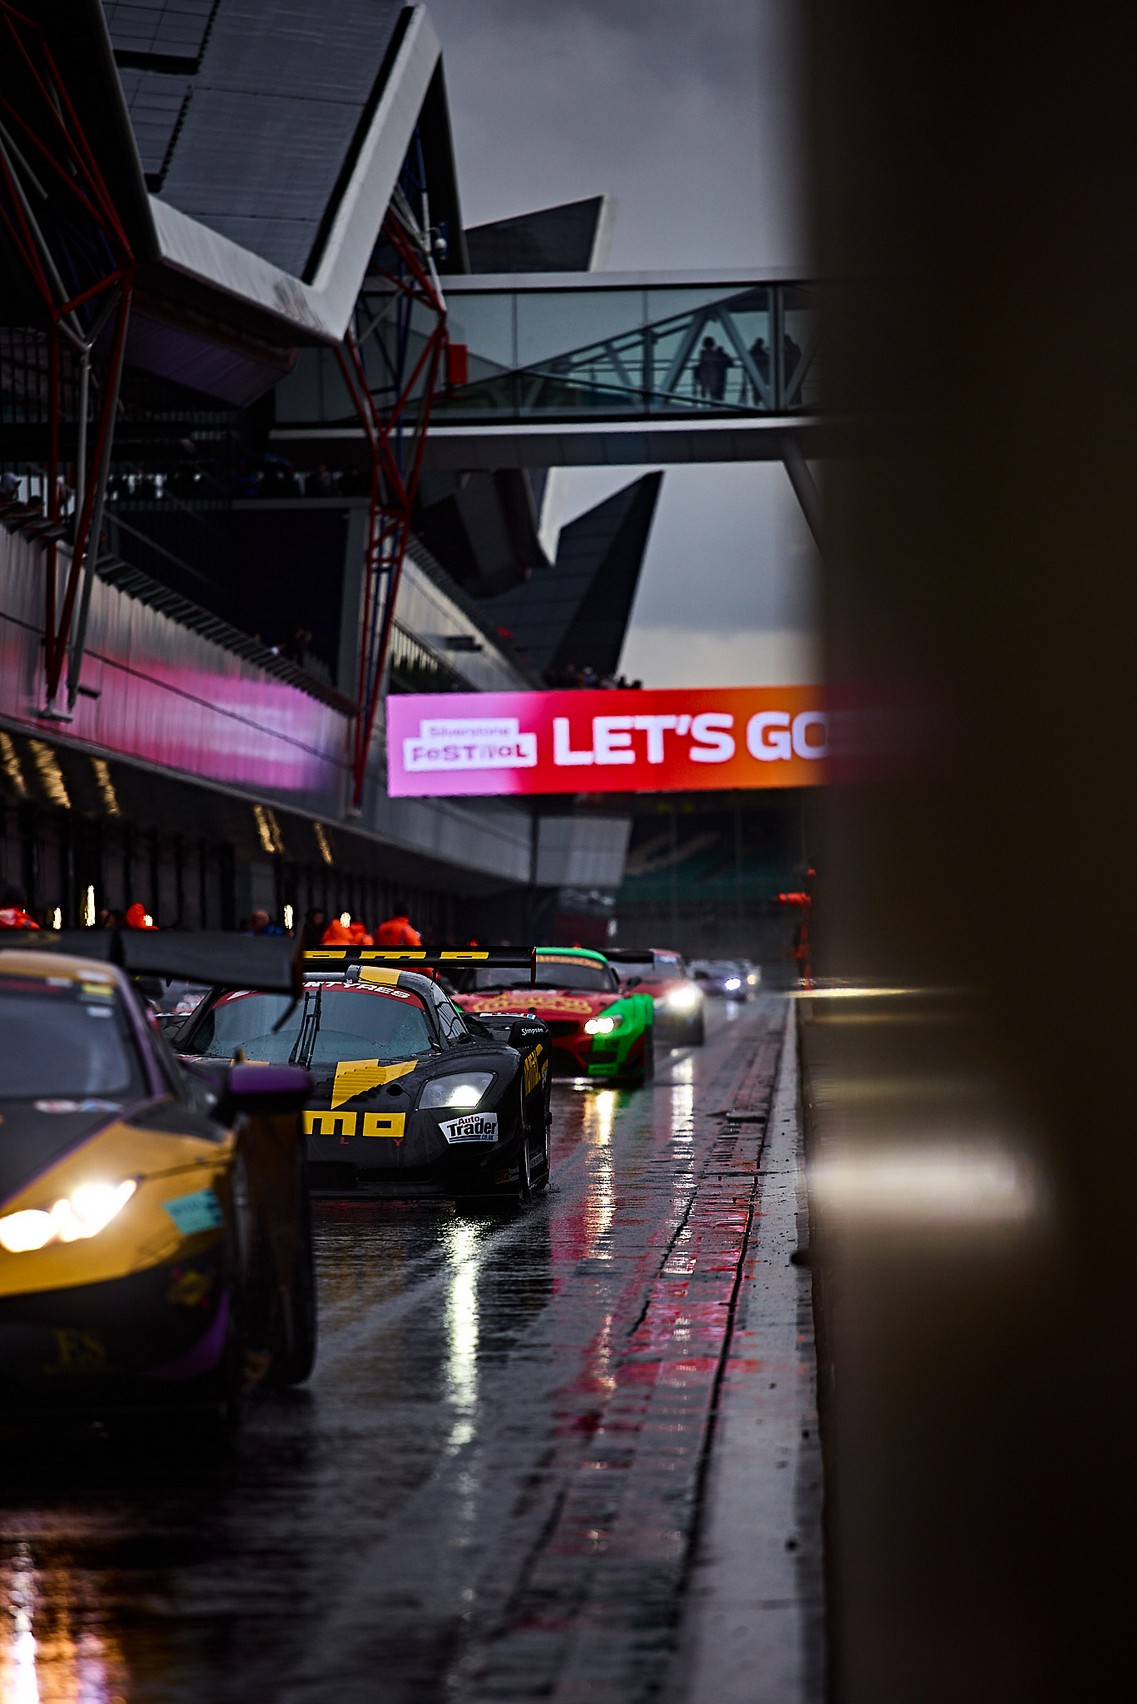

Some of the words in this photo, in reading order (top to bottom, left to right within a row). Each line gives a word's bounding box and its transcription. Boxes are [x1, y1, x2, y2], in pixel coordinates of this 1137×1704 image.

[553, 712, 735, 766] LET'S
[746, 711, 829, 761] GO
[447, 1118, 497, 1136] Trader
[458, 1115, 480, 1125] Auto
